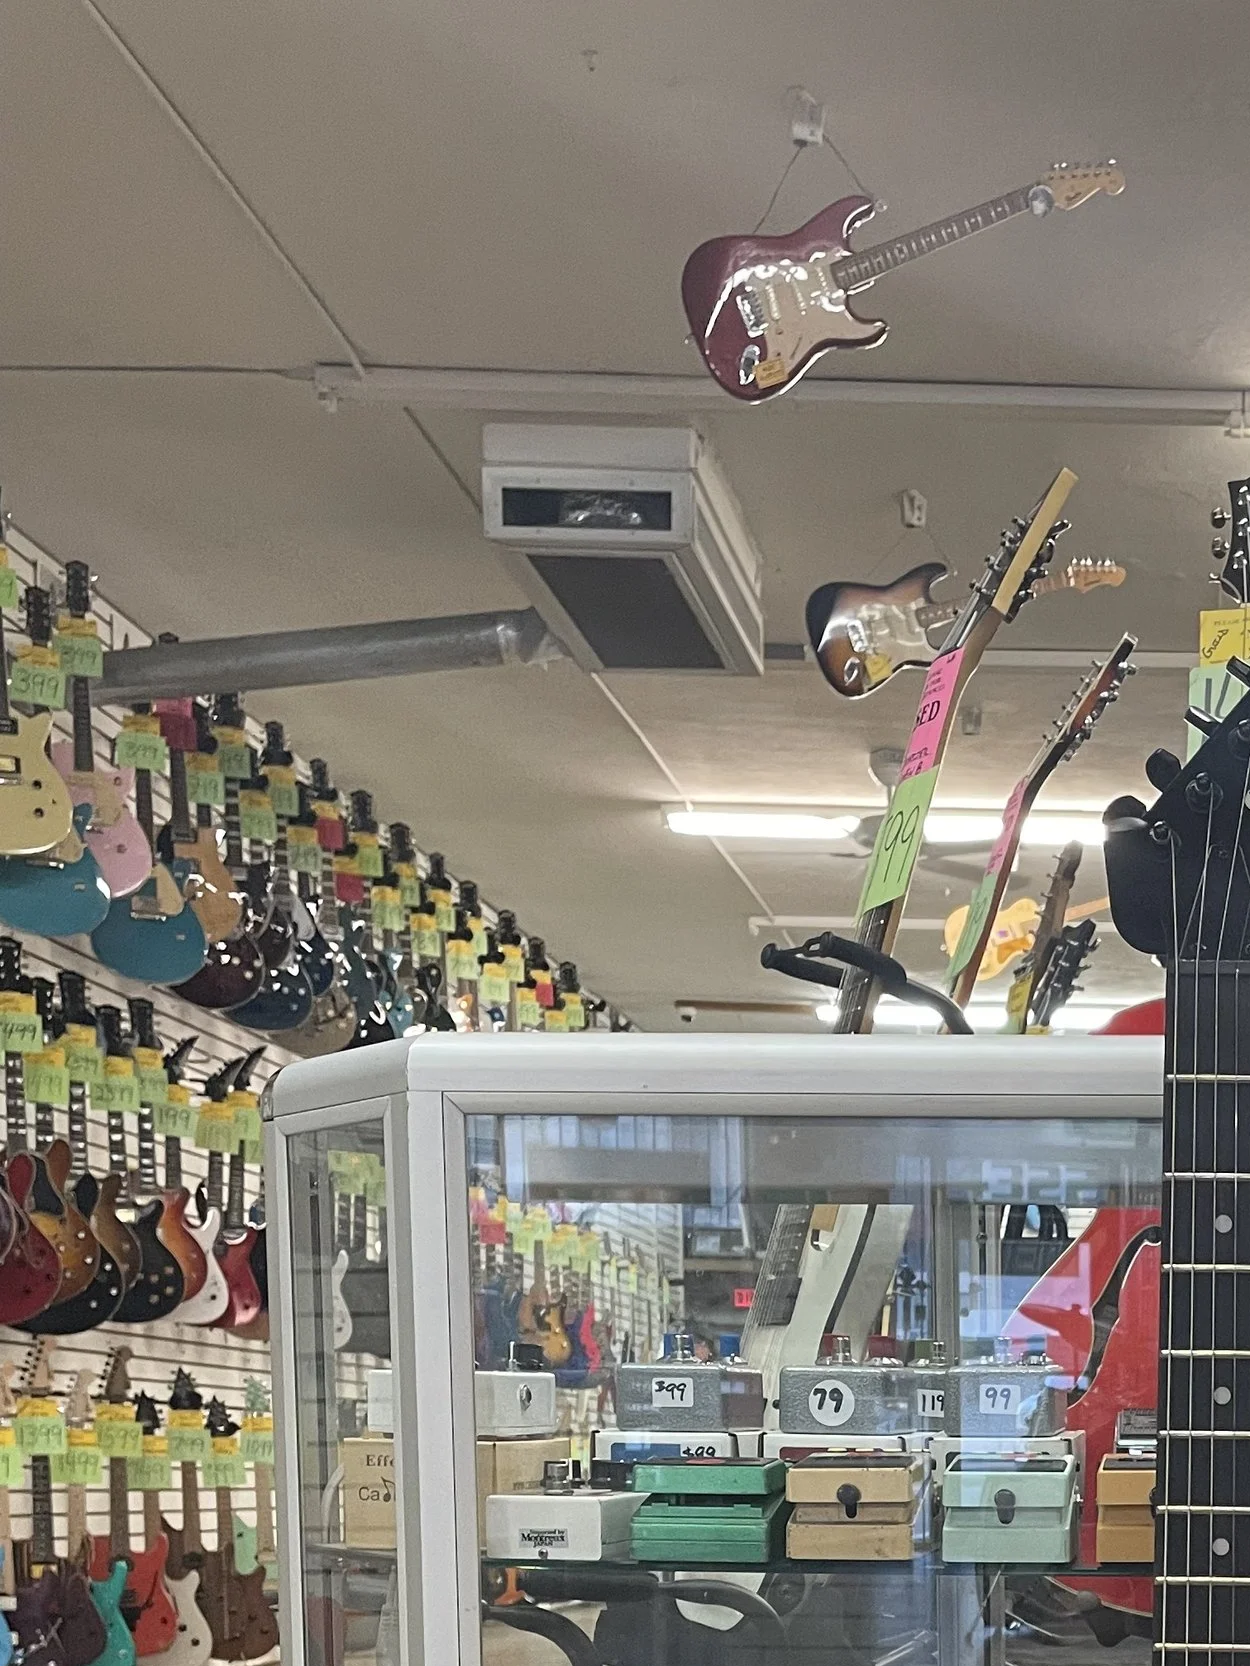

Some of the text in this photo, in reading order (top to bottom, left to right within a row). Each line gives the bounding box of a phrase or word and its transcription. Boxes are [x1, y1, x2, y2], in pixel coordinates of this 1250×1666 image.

[812, 1387, 844, 1413] 79
[921, 1393, 945, 1413] 119
[985, 1387, 1012, 1410] 99
